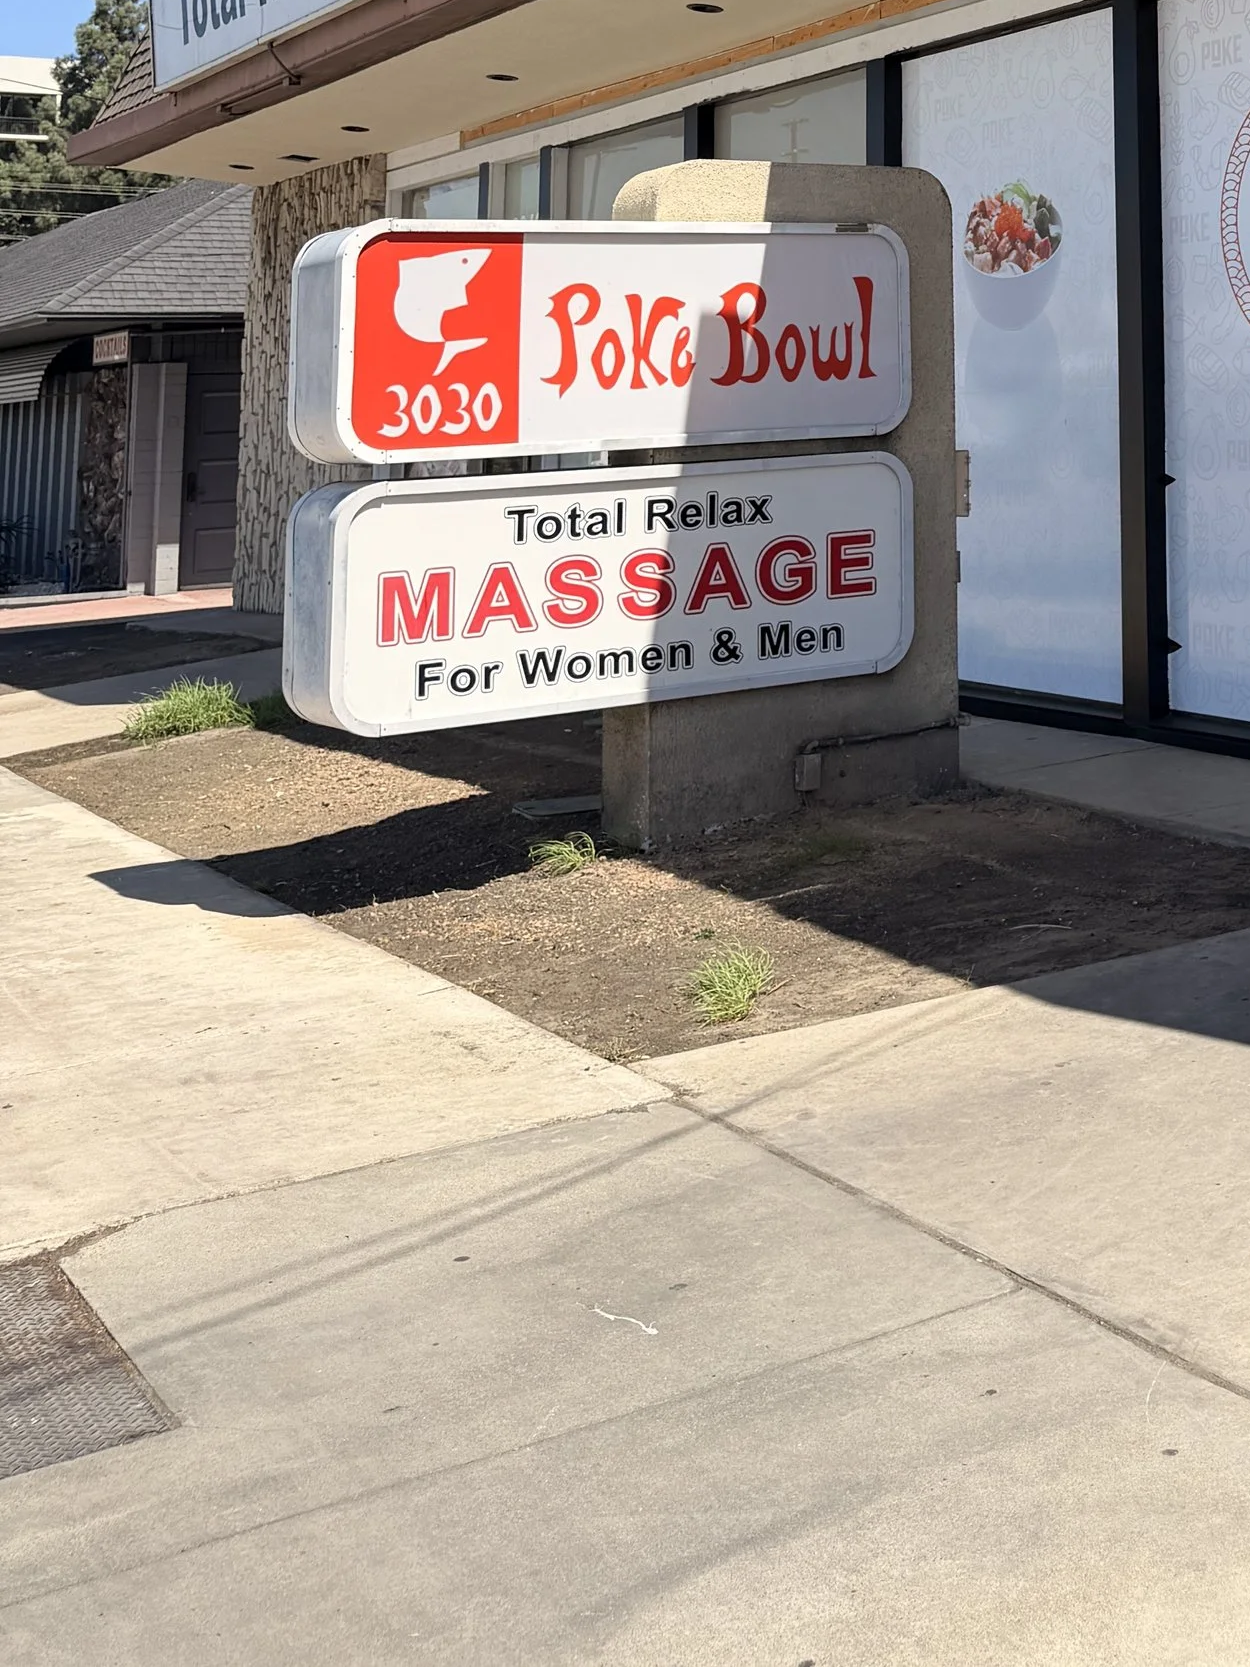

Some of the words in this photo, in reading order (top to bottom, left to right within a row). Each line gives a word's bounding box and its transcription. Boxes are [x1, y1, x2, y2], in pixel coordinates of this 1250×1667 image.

[1202, 34, 1243, 71] POKE
[95, 335, 127, 359] COCKTAILS
[710, 276, 877, 387] Bowl
[377, 382, 502, 437] 3030
[506, 498, 625, 546] Total
[645, 490, 773, 532] Relax
[376, 528, 877, 647] MASSAGE
[415, 654, 502, 701] For
[519, 639, 693, 690] Women
[711, 629, 742, 664] &
[758, 621, 845, 660] Men
